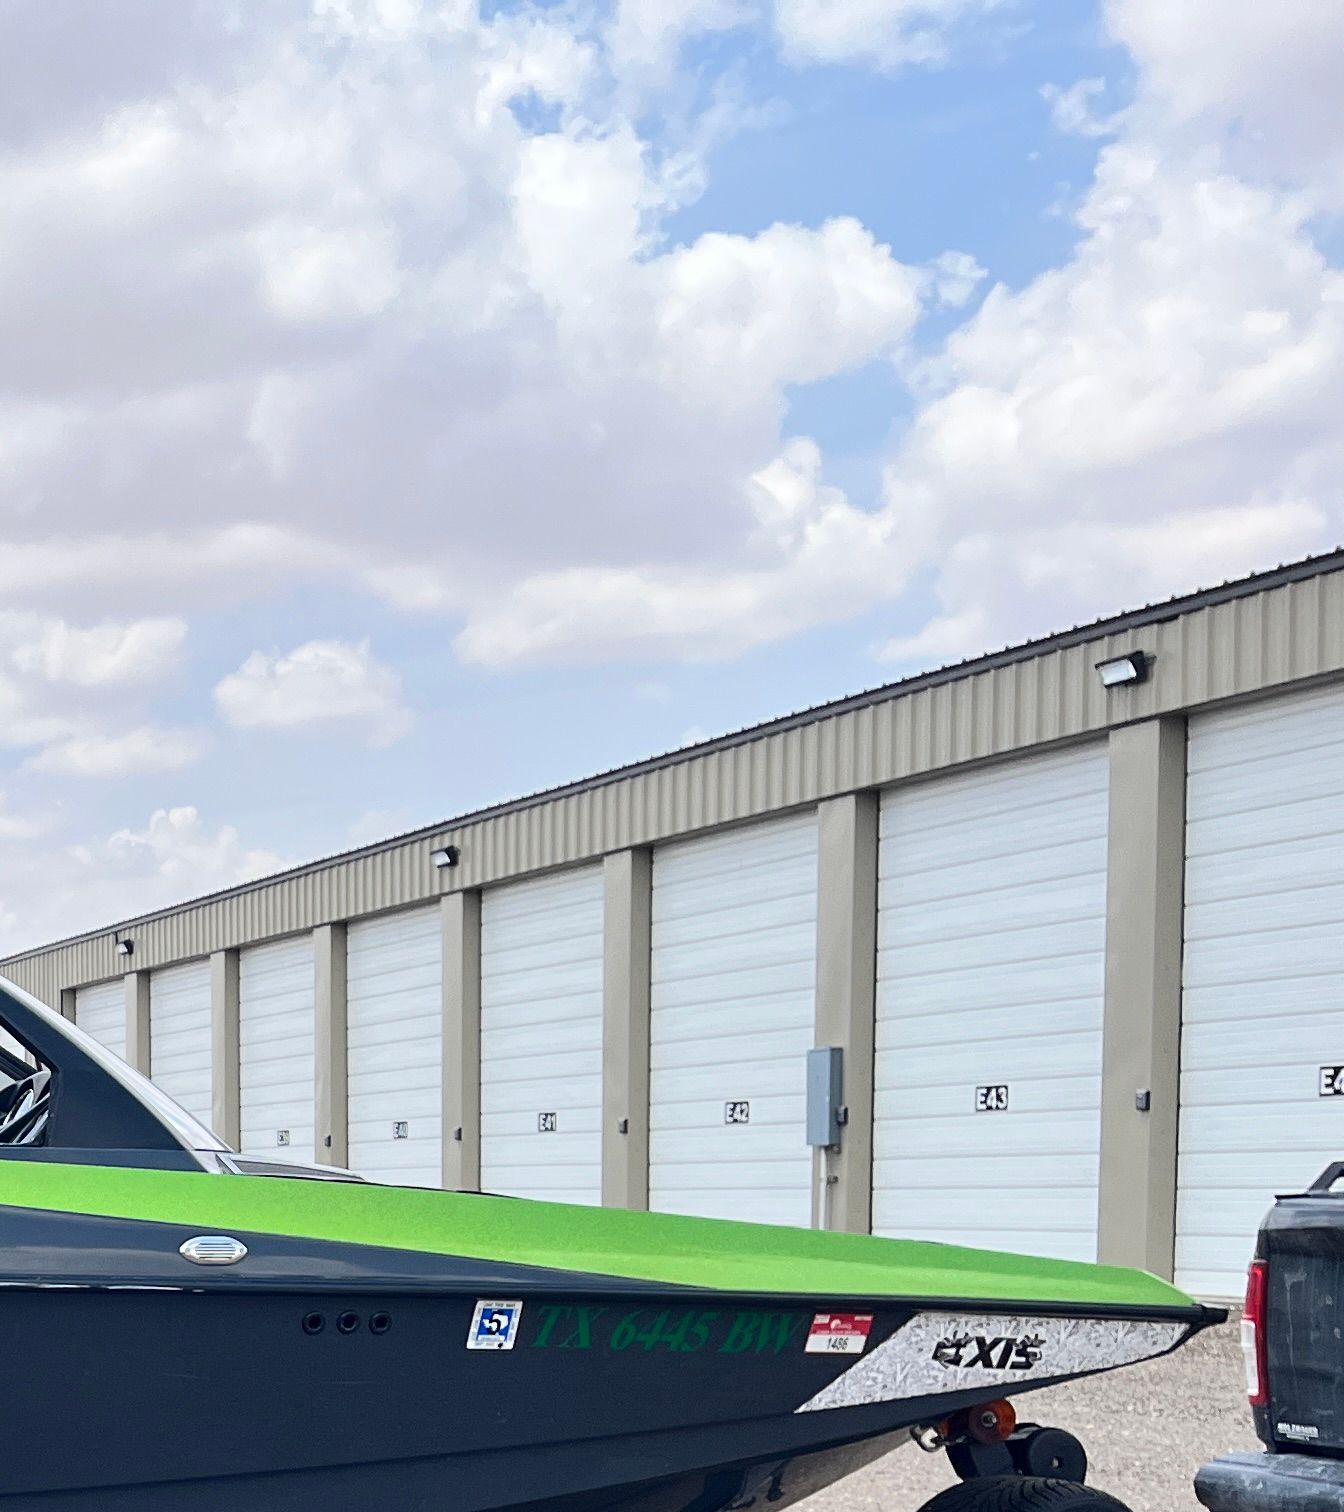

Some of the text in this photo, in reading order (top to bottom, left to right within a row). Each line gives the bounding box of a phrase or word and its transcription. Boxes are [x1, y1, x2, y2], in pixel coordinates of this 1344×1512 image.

[1321, 1068, 1344, 1095] E4
[977, 1087, 1007, 1110] E43
[726, 1102, 749, 1124] E42
[529, 1304, 610, 1349] TX
[611, 1309, 721, 1352] 6445
